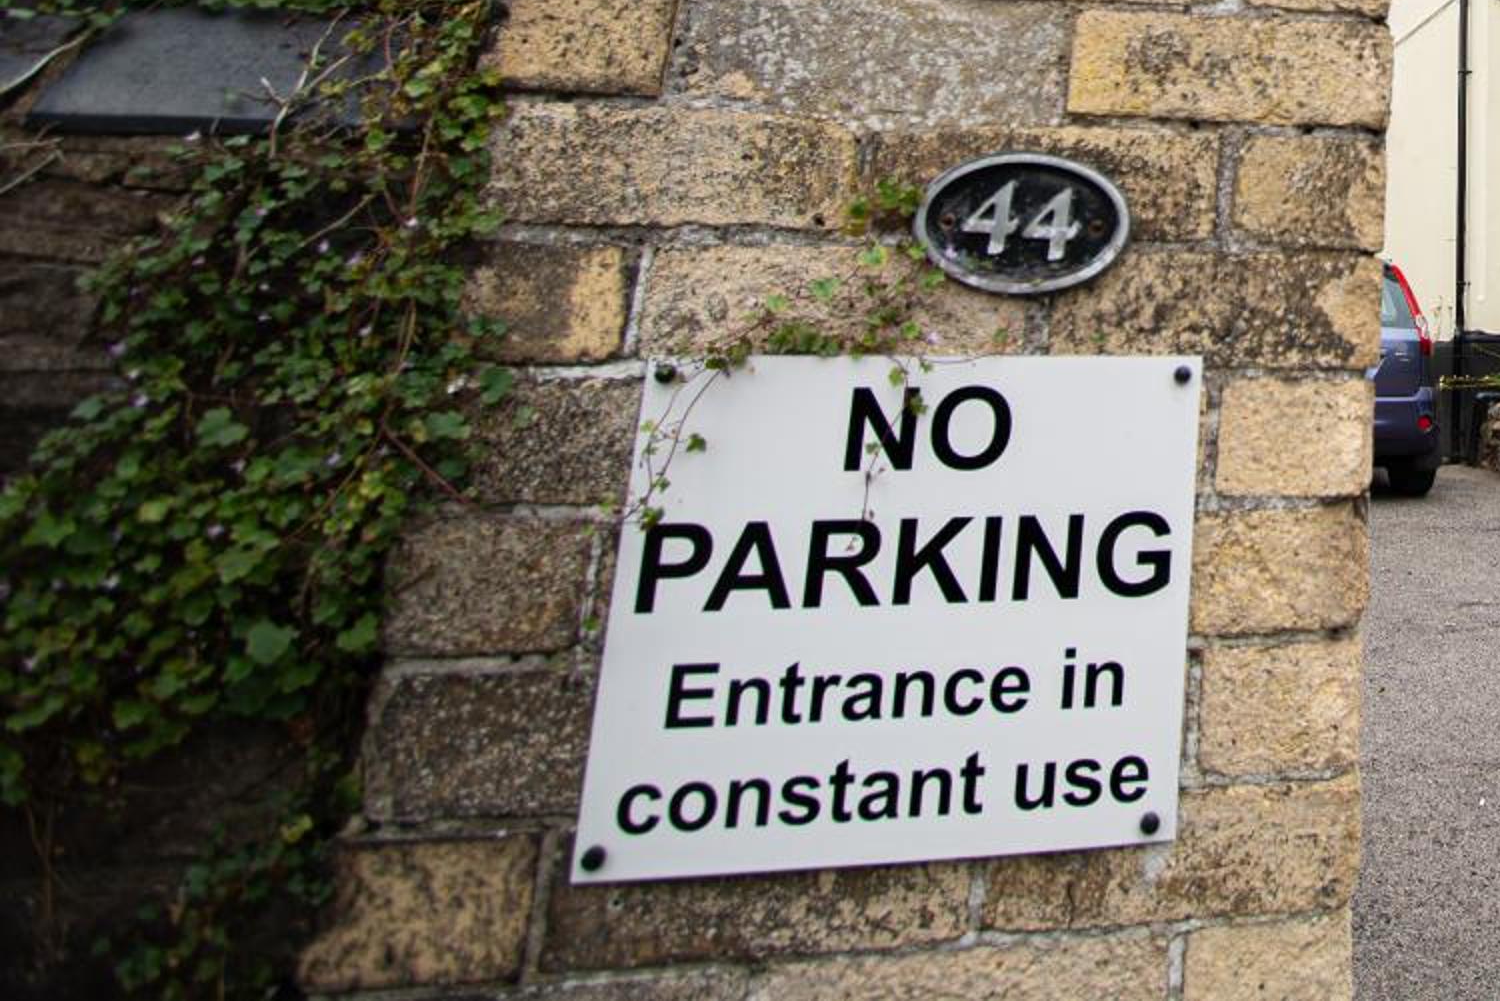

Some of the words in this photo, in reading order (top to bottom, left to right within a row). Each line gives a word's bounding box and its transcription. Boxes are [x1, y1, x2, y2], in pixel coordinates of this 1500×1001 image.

[961, 179, 1082, 262] 44
[843, 385, 1013, 472] NO
[632, 511, 1174, 614] PARKING
[664, 660, 1031, 730] Entrance
[1060, 648, 1126, 710] in
[615, 752, 986, 835] constant
[1012, 753, 1150, 810] use
